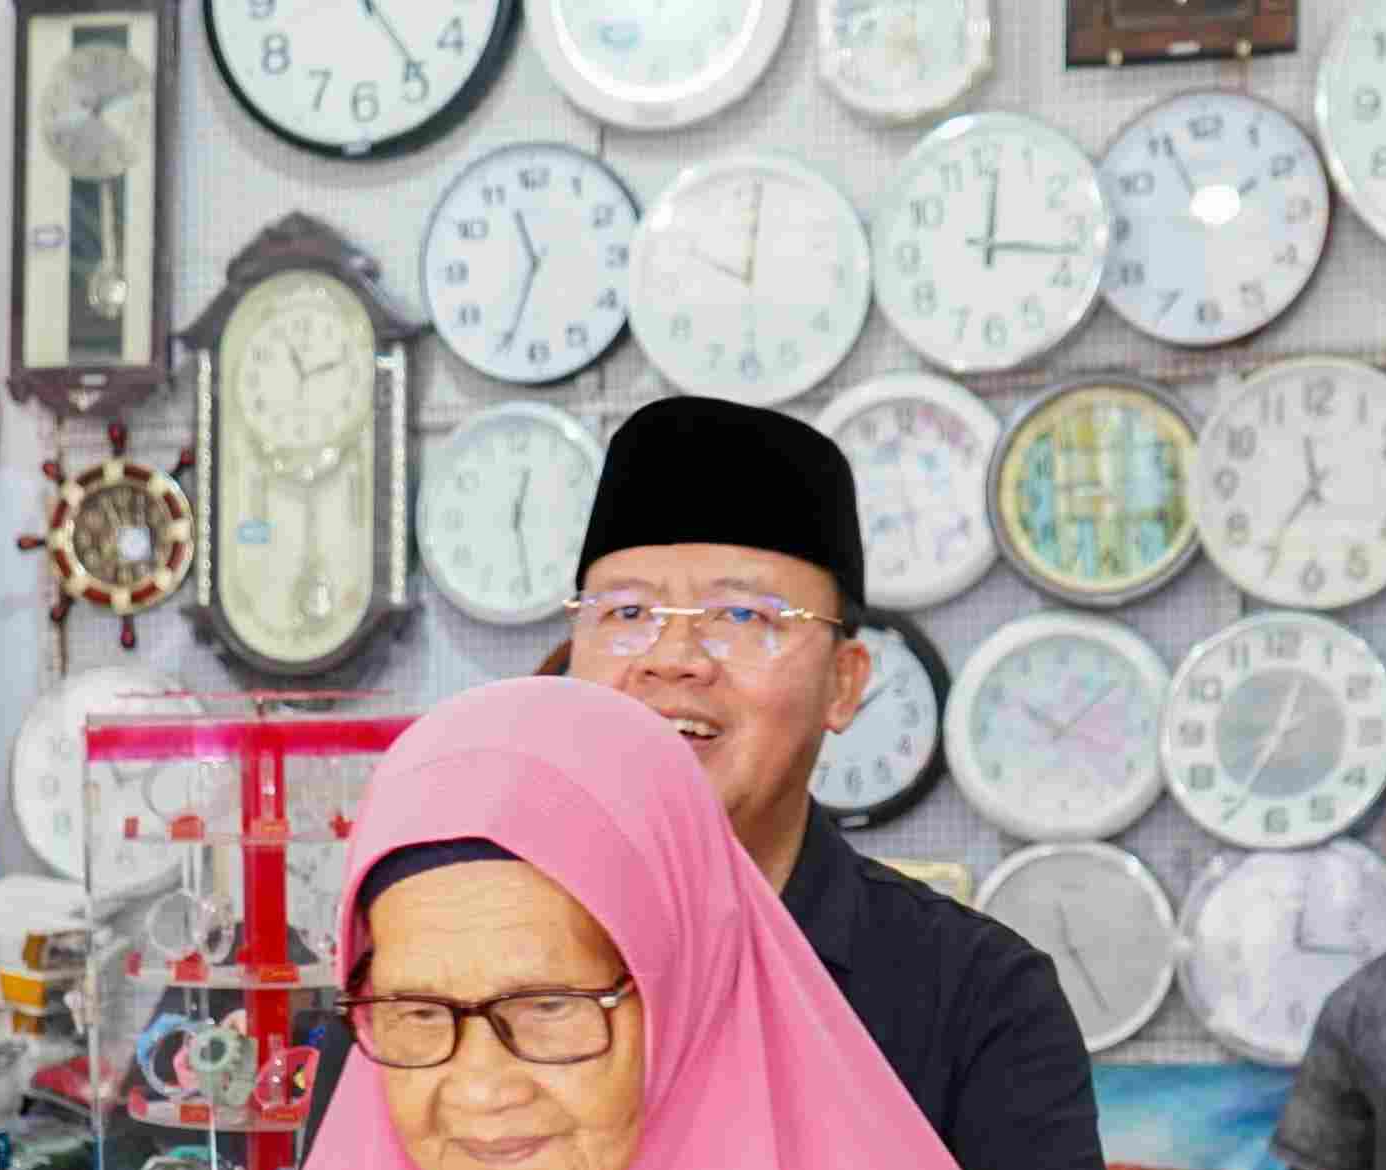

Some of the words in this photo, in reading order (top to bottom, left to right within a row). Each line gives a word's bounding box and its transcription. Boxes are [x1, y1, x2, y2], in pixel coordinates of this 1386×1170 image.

[261, 32, 290, 75] 8
[437, 16, 465, 54] 4
[309, 67, 332, 111] 7
[350, 81, 380, 123] 6
[1354, 86, 1381, 121] 9
[1303, 376, 1334, 416] 12
